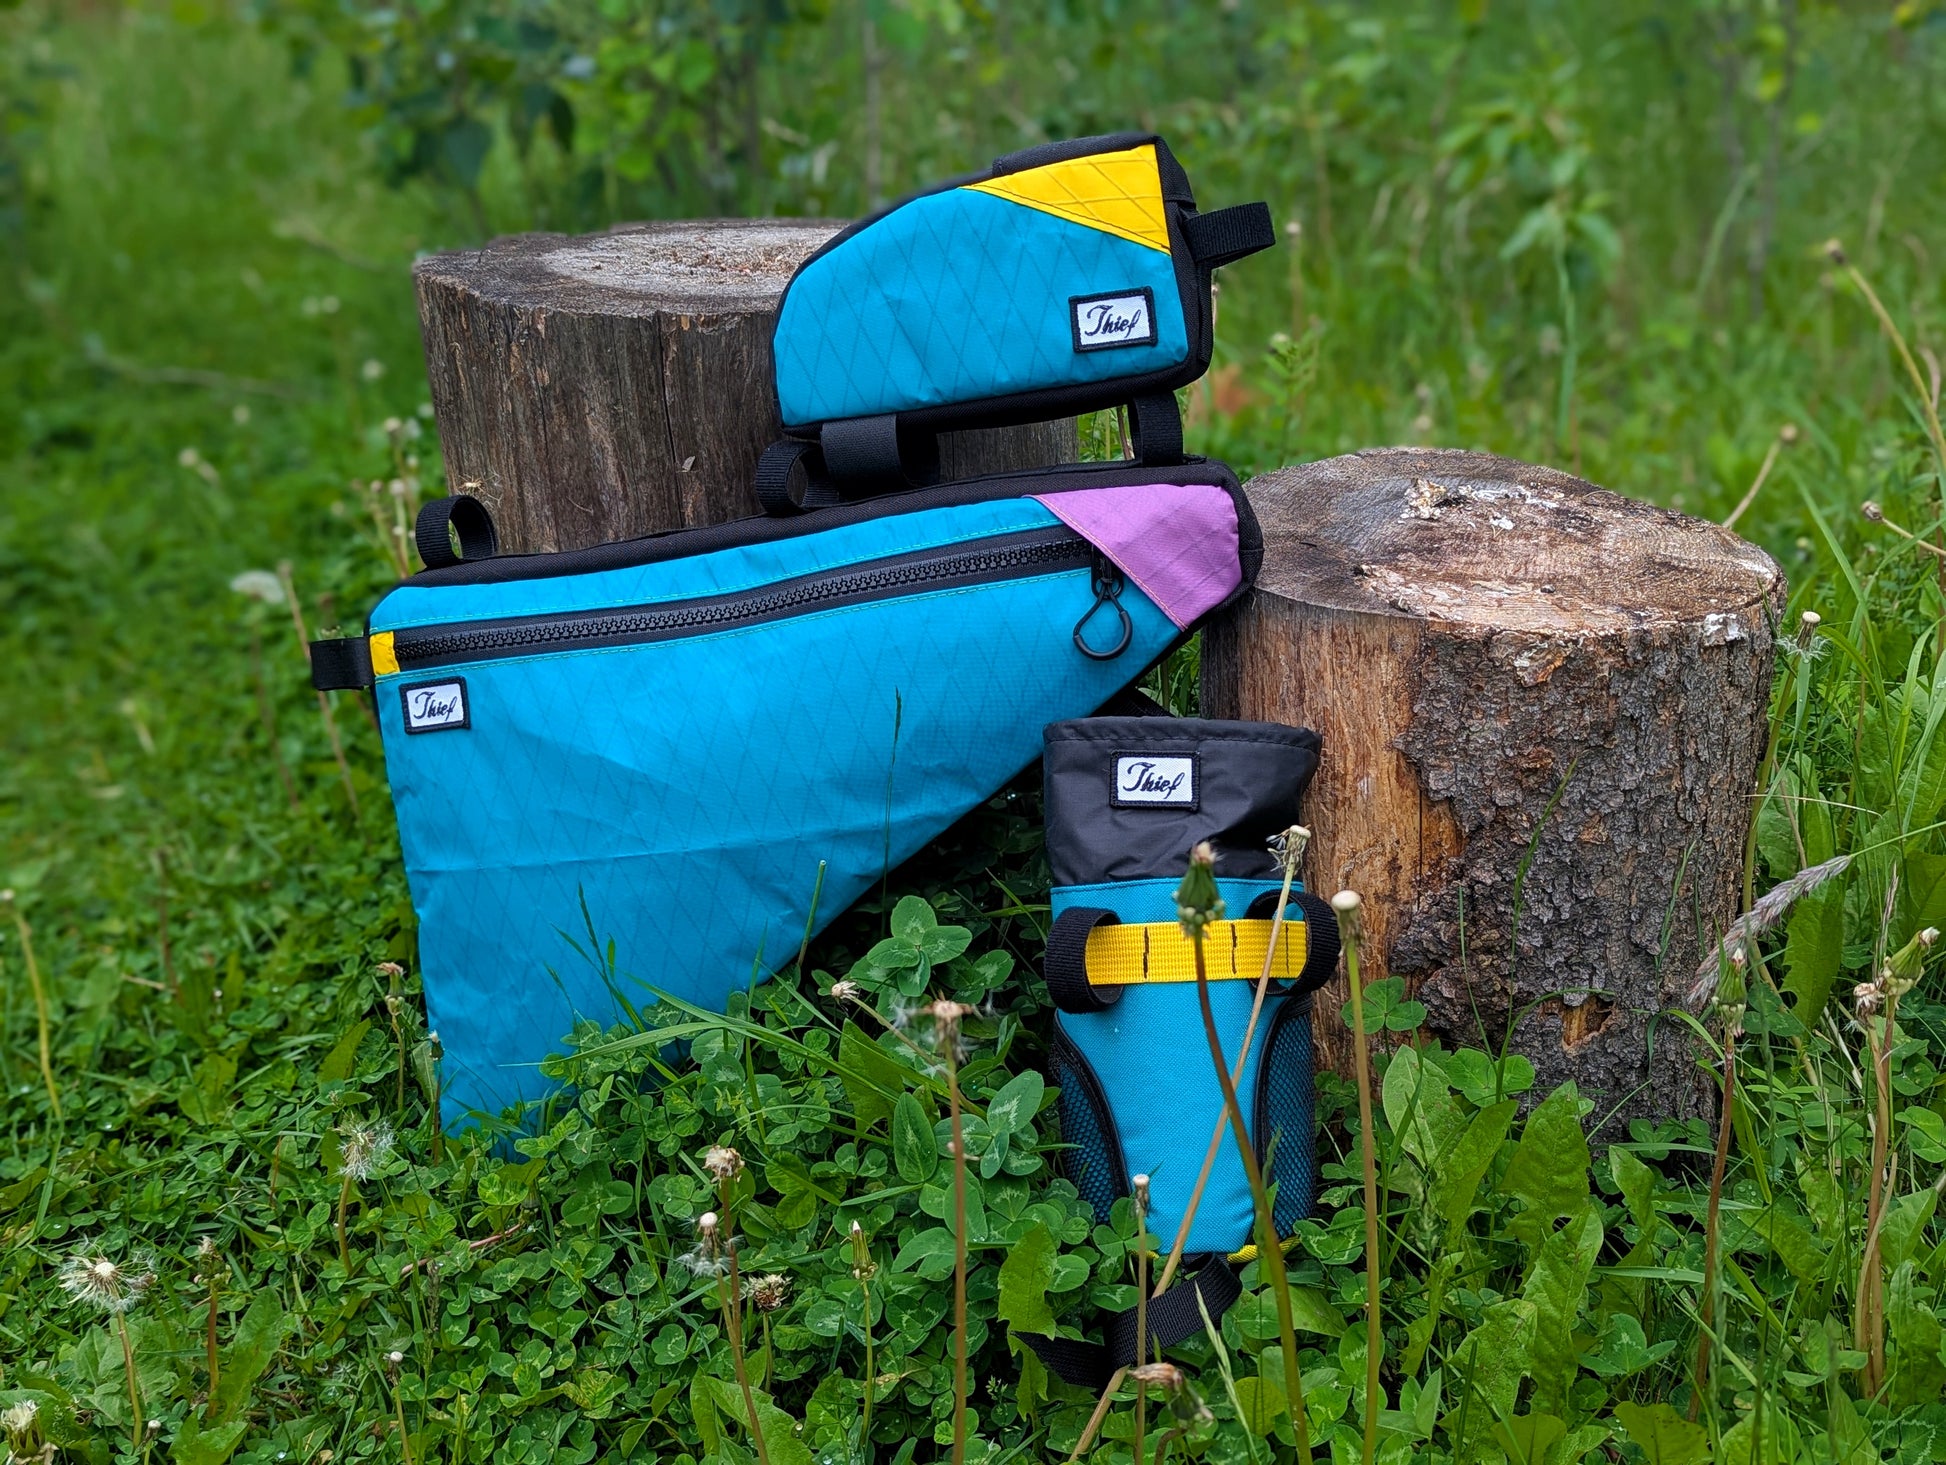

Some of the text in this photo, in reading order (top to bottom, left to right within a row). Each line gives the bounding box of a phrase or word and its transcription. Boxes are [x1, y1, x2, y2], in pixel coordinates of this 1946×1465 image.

[1084, 304, 1141, 338] Thief
[413, 691, 457, 721] Thief
[1122, 762, 1185, 799] Thief
